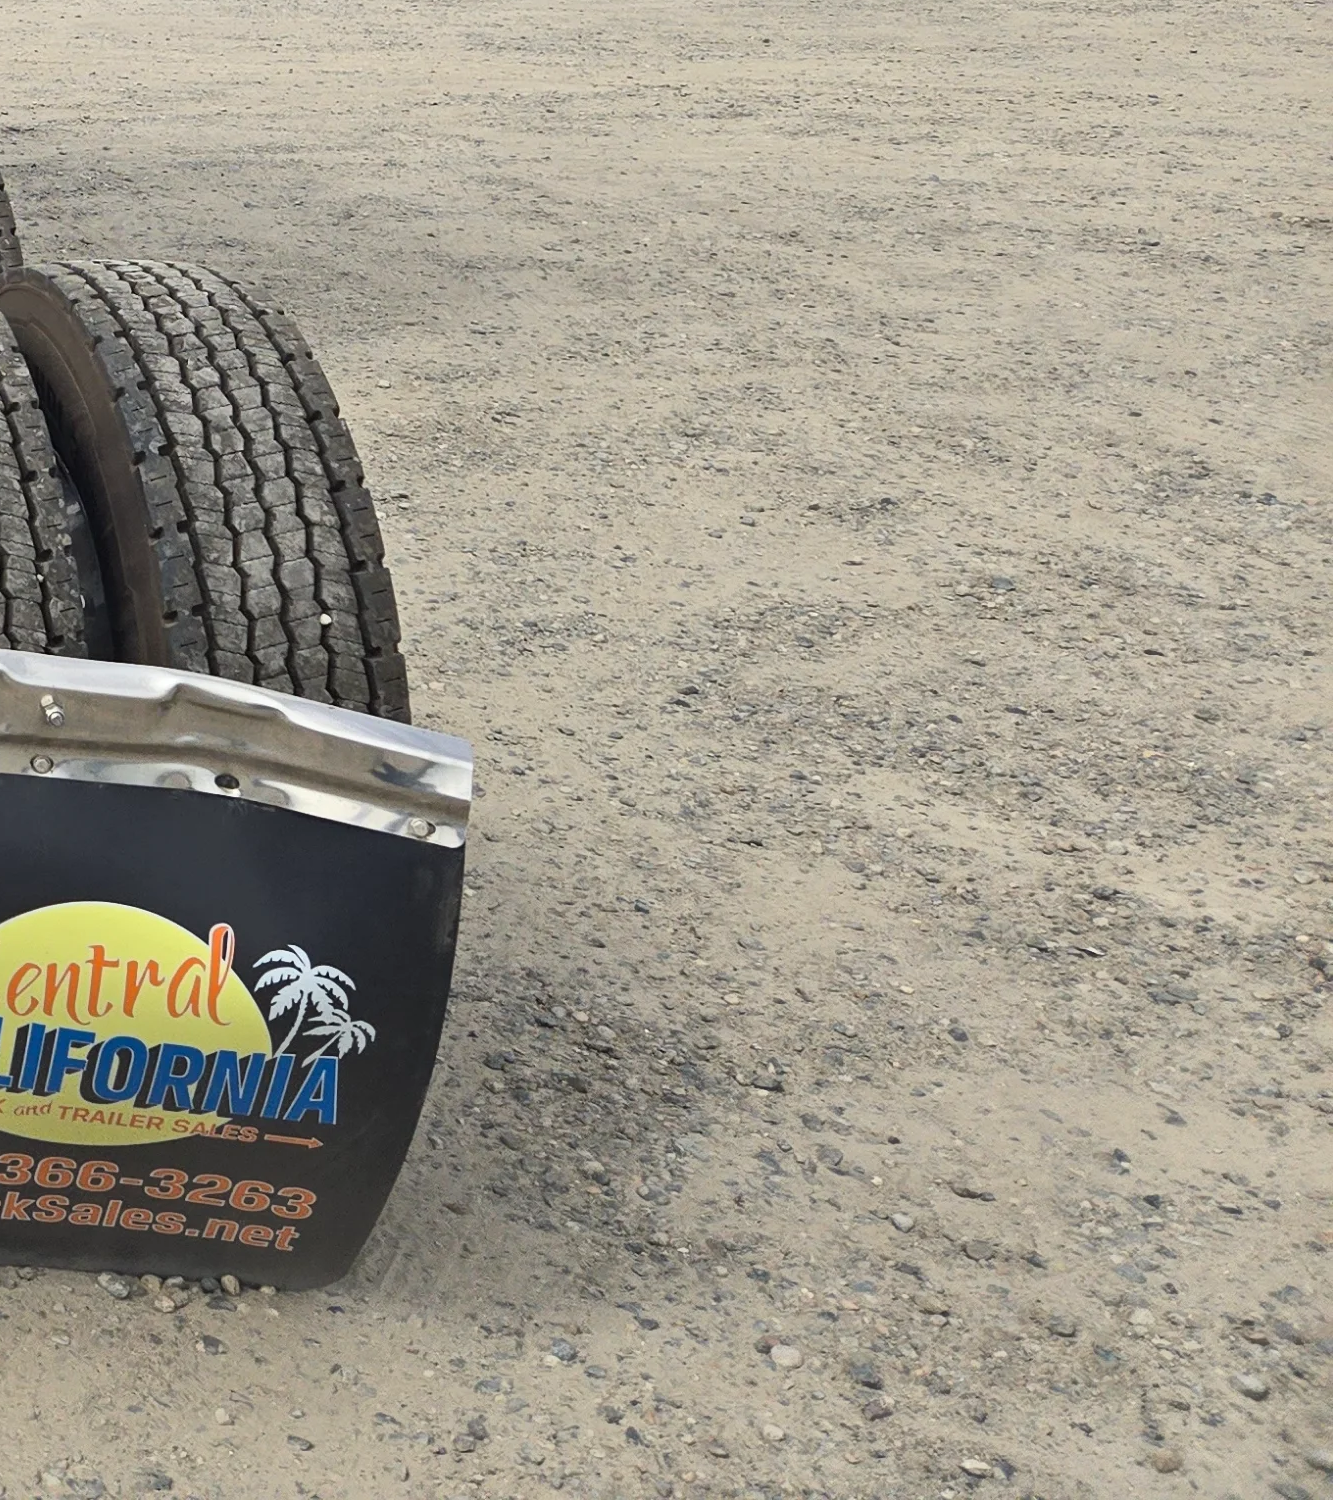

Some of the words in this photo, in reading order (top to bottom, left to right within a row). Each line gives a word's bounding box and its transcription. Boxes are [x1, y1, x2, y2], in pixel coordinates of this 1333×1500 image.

[14, 1102, 53, 1118] and
[58, 1104, 165, 1132] TRAILER
[172, 1117, 259, 1144] SALES
